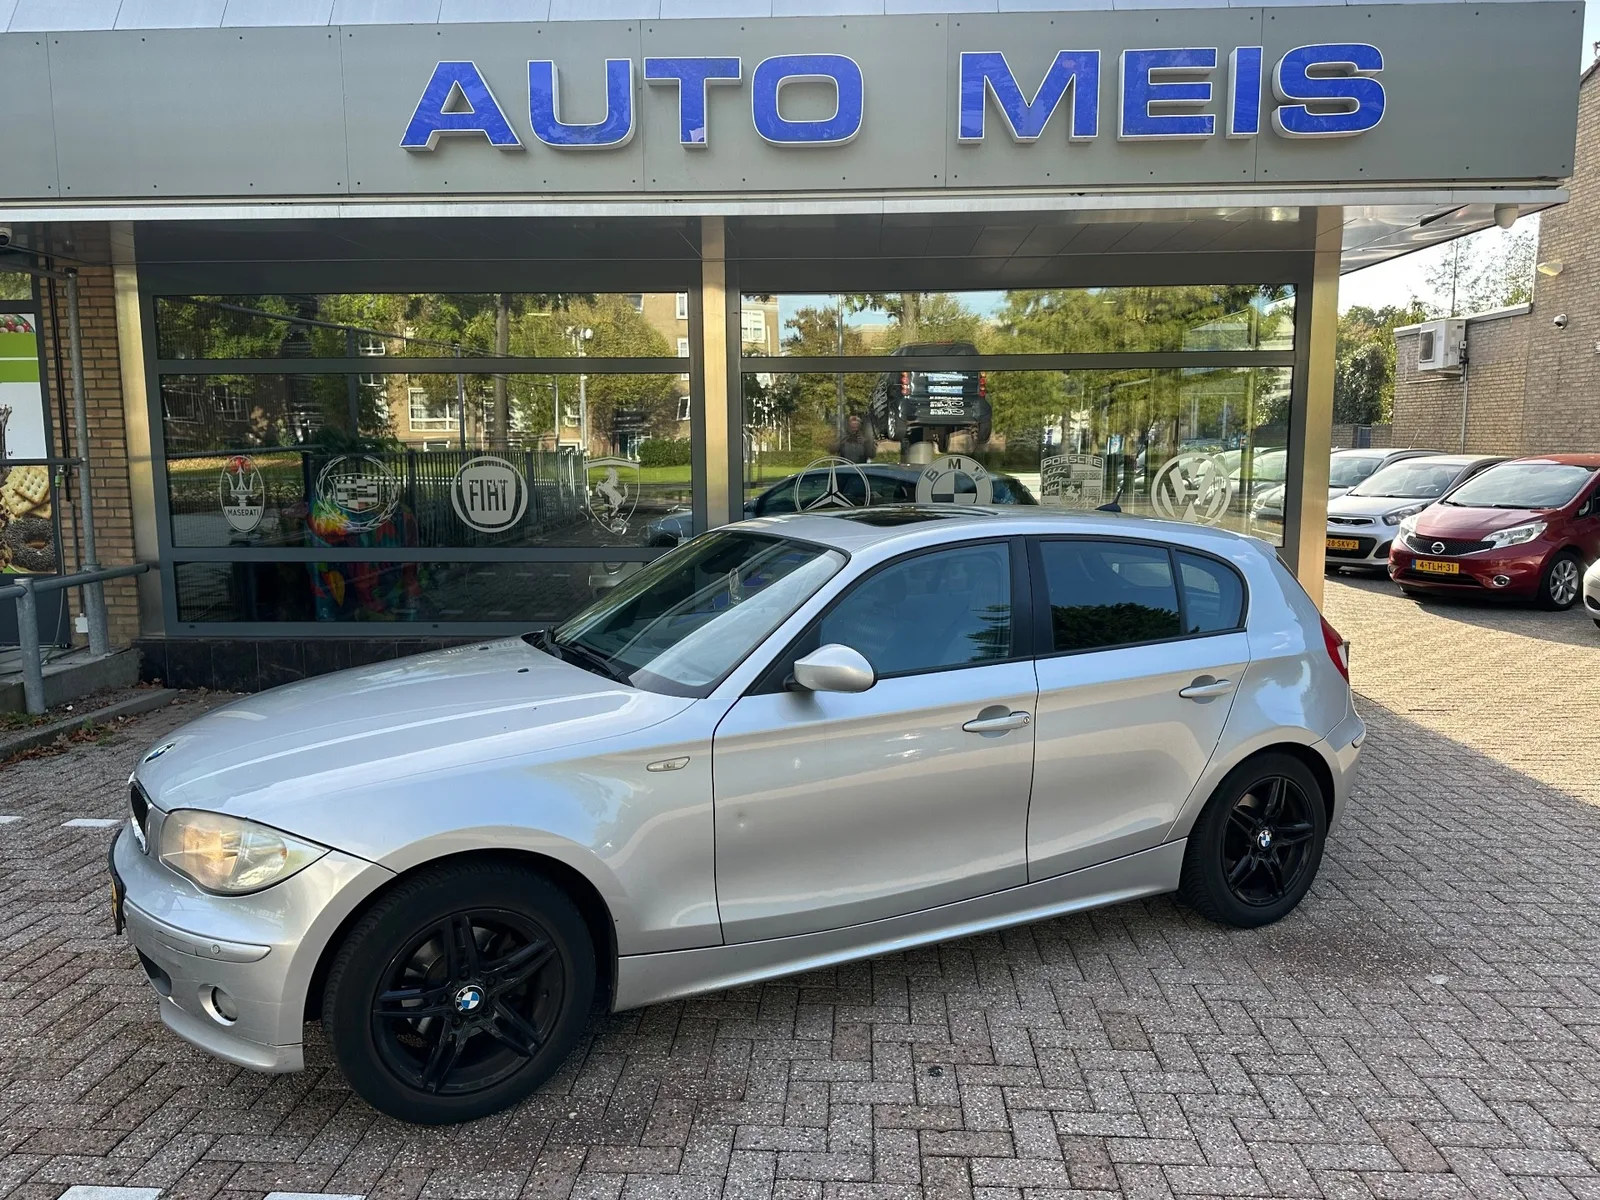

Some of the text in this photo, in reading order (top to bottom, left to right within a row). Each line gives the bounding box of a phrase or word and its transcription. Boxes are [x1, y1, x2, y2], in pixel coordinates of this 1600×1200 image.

[400, 43, 1387, 152] AUTO MEIS
[1042, 455, 1102, 468] PORSCHE
[923, 458, 987, 483] BMW
[468, 479, 508, 511] FIAT
[227, 508, 260, 517] MASERATI
[1326, 539, 1357, 548] 28-SKV-2
[1419, 561, 1454, 572] 4-TLH-31
